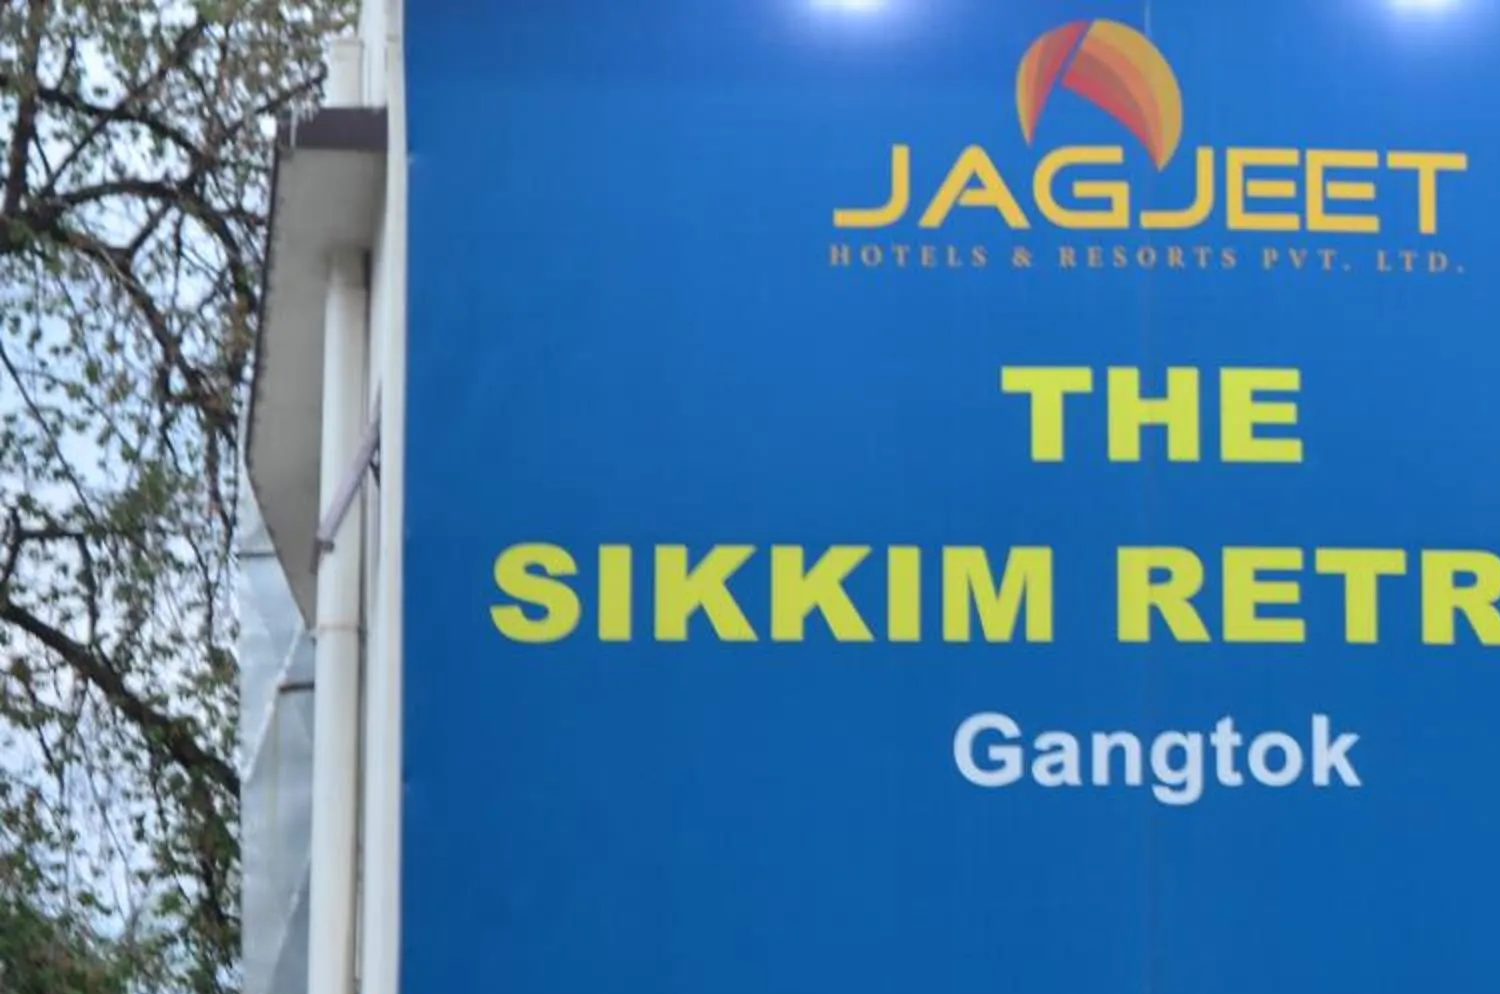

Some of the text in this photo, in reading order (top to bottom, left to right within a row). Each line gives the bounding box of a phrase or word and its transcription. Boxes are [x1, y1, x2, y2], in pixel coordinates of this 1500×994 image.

[833, 144, 1468, 234] JAGJEET
[829, 243, 1464, 273] HOTELS & RESORTS PVT. LTD.
[1001, 366, 1303, 463] THE
[490, 544, 1053, 643] SIKKIM
[953, 713, 1361, 805] Gangtok
